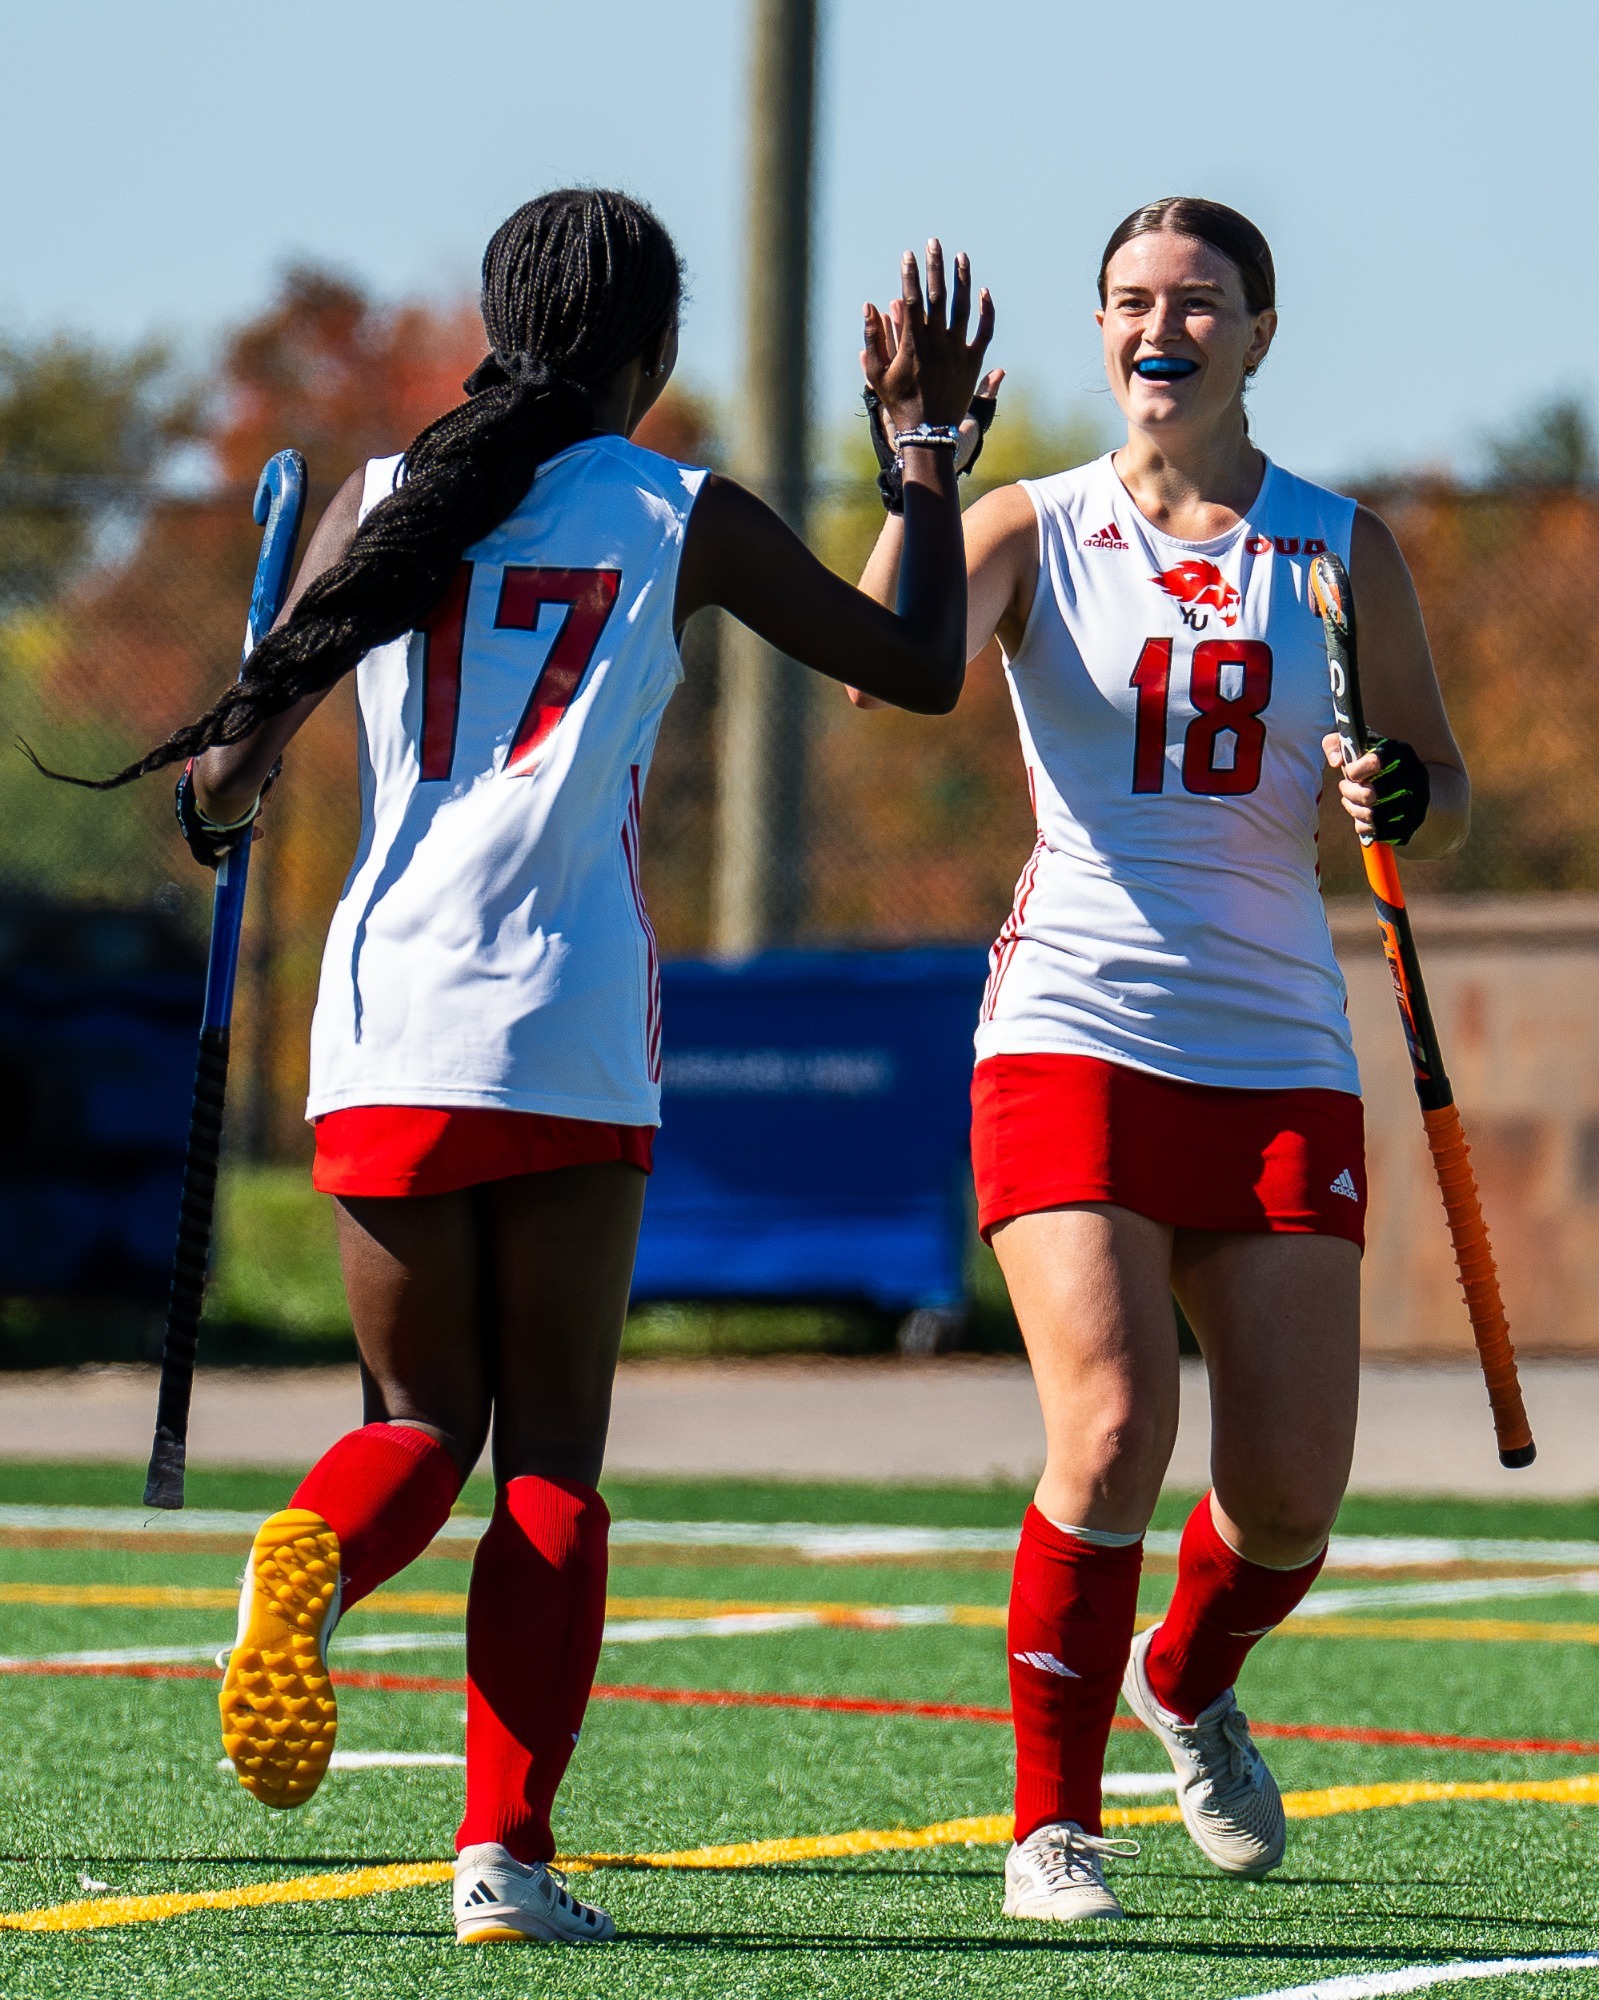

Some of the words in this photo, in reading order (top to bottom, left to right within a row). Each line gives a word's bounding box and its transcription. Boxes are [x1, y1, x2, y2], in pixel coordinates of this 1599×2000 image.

[1083, 537, 1129, 550] adidas
[1245, 535, 1329, 557] OUA
[1180, 605, 1208, 631] YU
[416, 560, 623, 783] 17
[1129, 637, 1273, 796] 18
